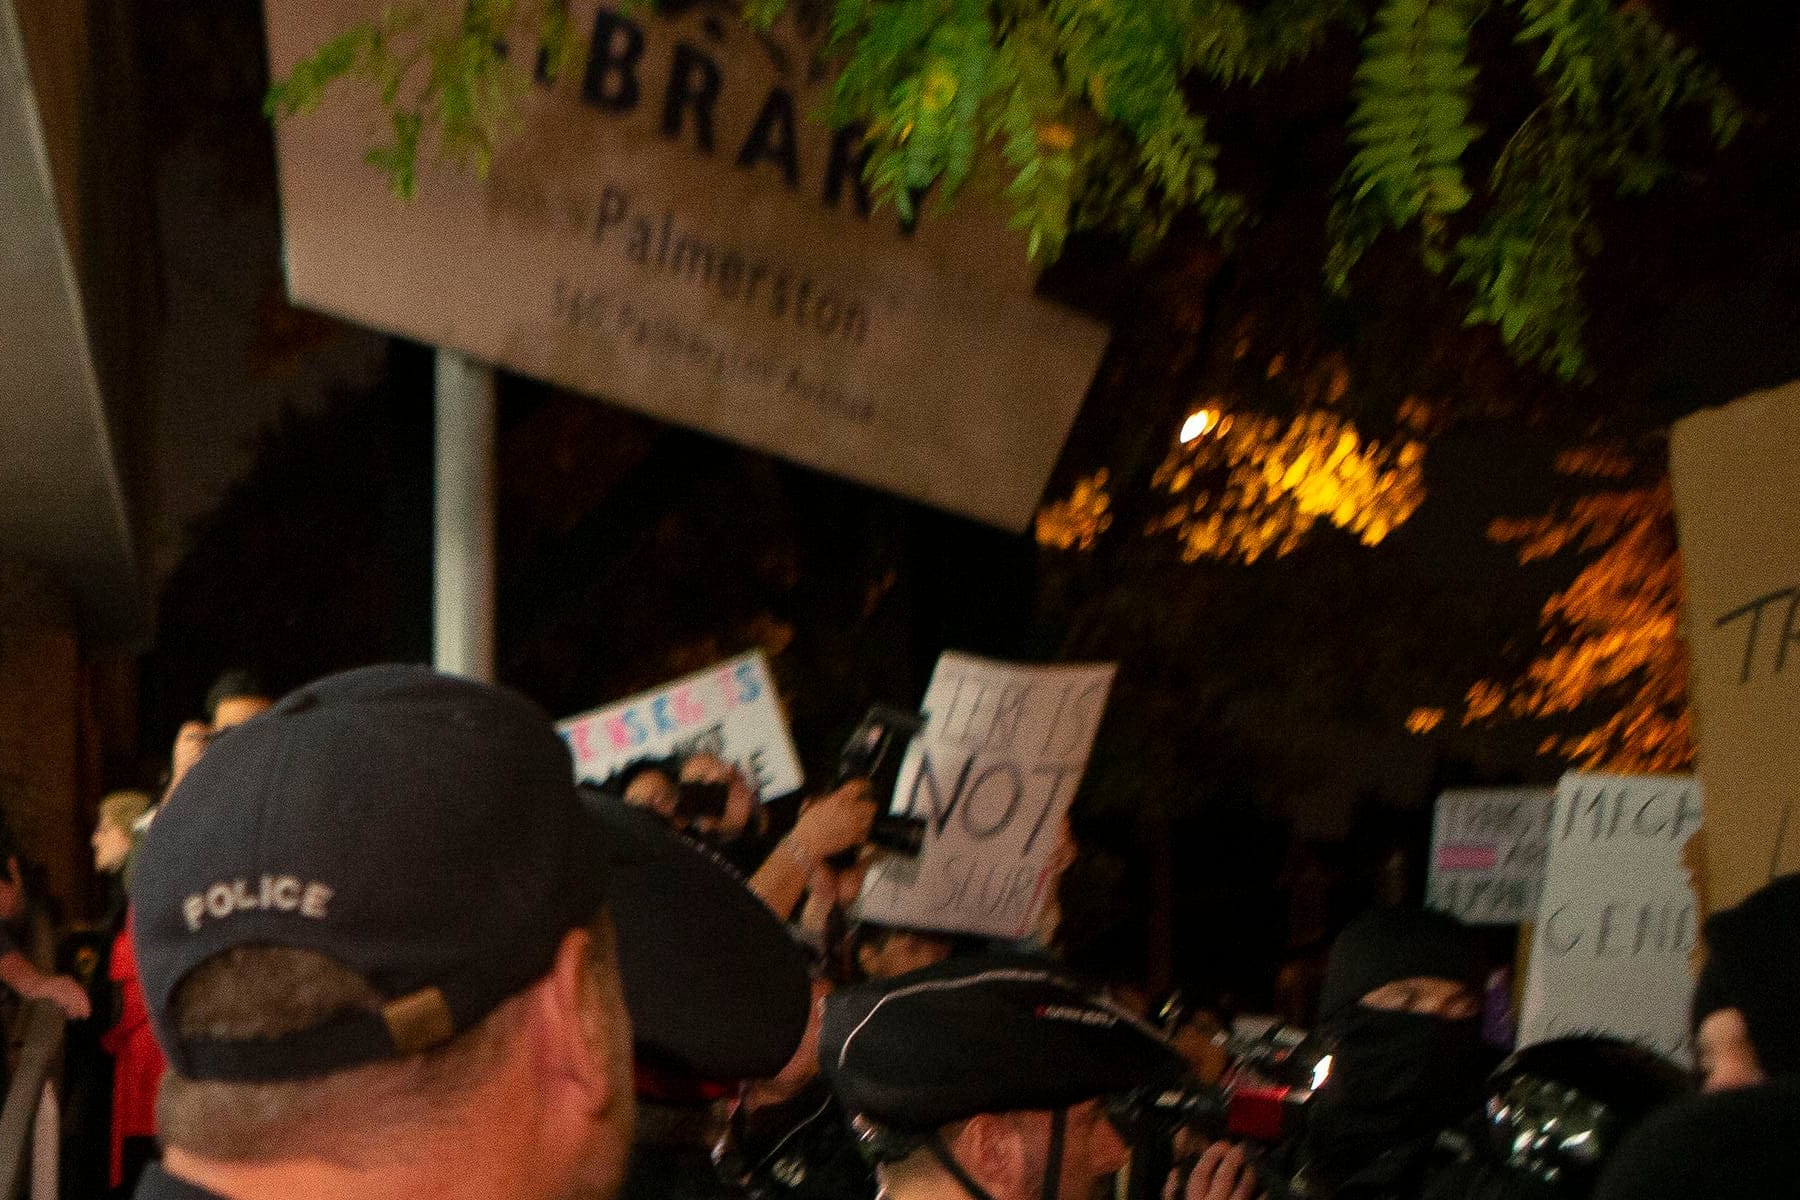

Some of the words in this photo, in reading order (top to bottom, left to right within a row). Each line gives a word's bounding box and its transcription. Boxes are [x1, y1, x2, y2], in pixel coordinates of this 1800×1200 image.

[492, 8, 933, 238] BRAR
[593, 184, 870, 343] Palmerston
[904, 752, 1086, 856] NOT
[182, 874, 335, 932] POLICE
